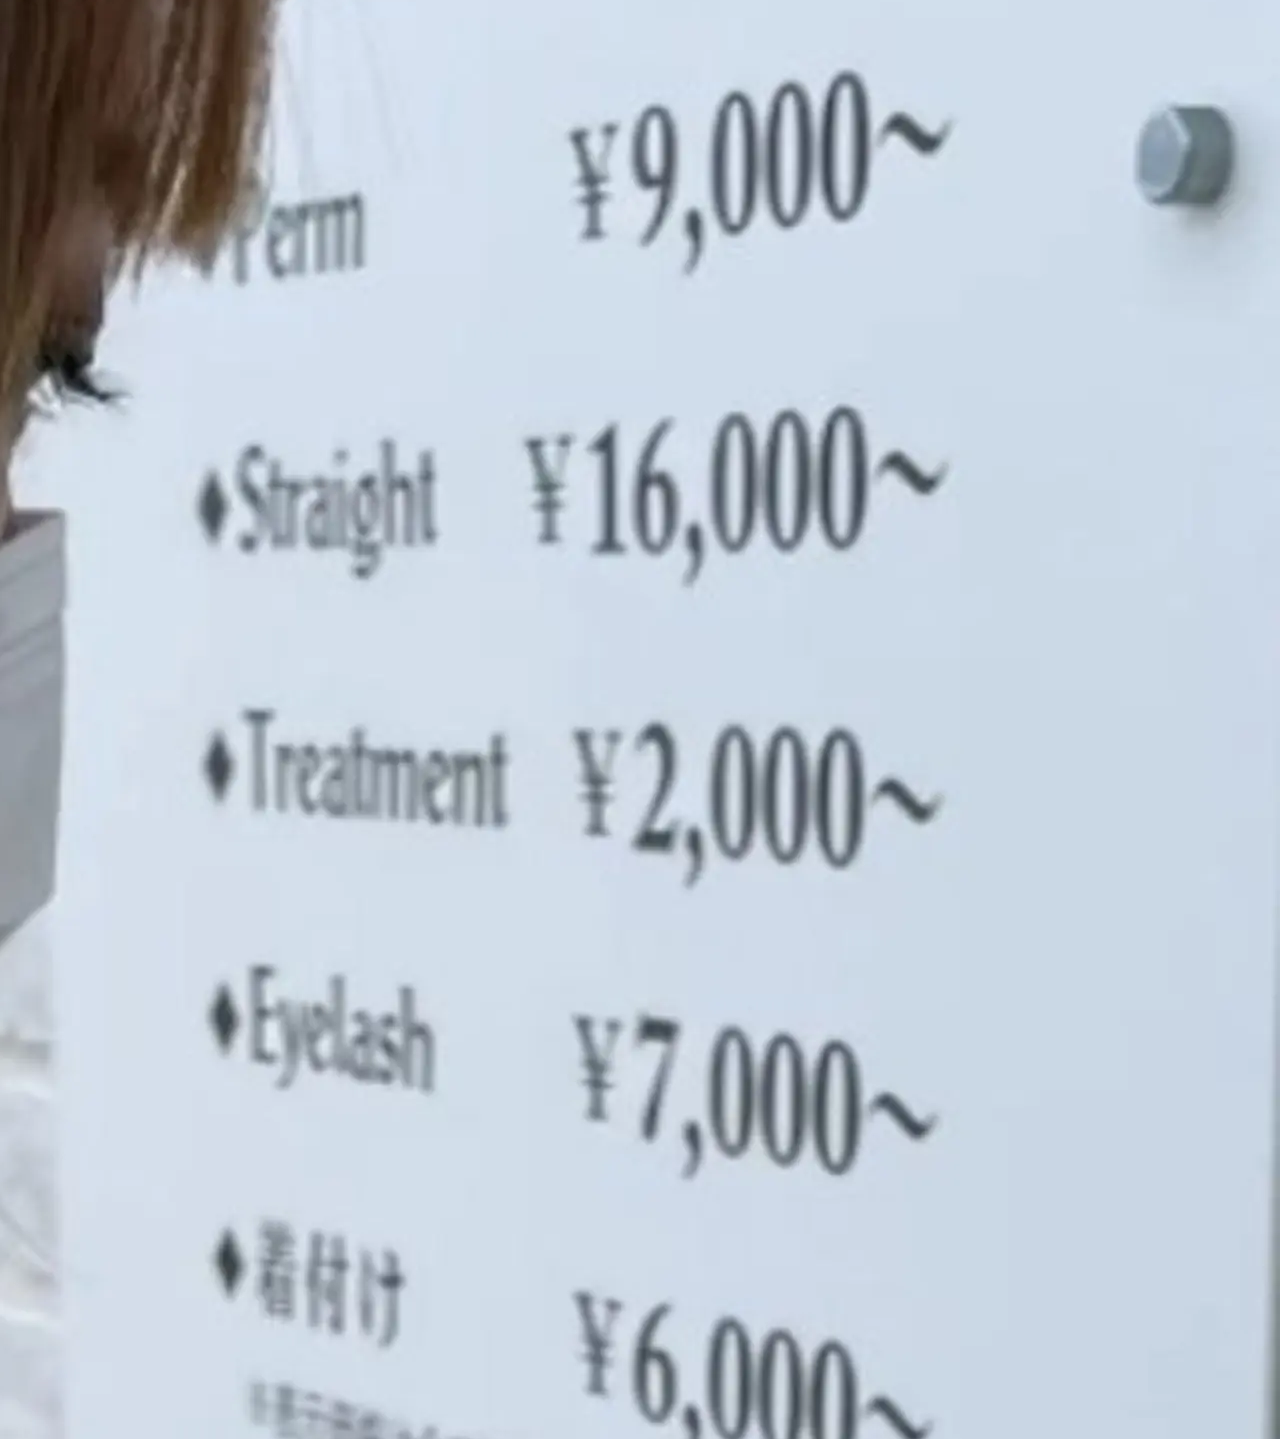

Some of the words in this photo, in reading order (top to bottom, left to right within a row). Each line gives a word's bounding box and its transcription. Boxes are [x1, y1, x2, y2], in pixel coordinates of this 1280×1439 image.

[236, 438, 438, 580] Straight
[242, 708, 509, 828] Treatment
[248, 964, 435, 1092] Eyelash
